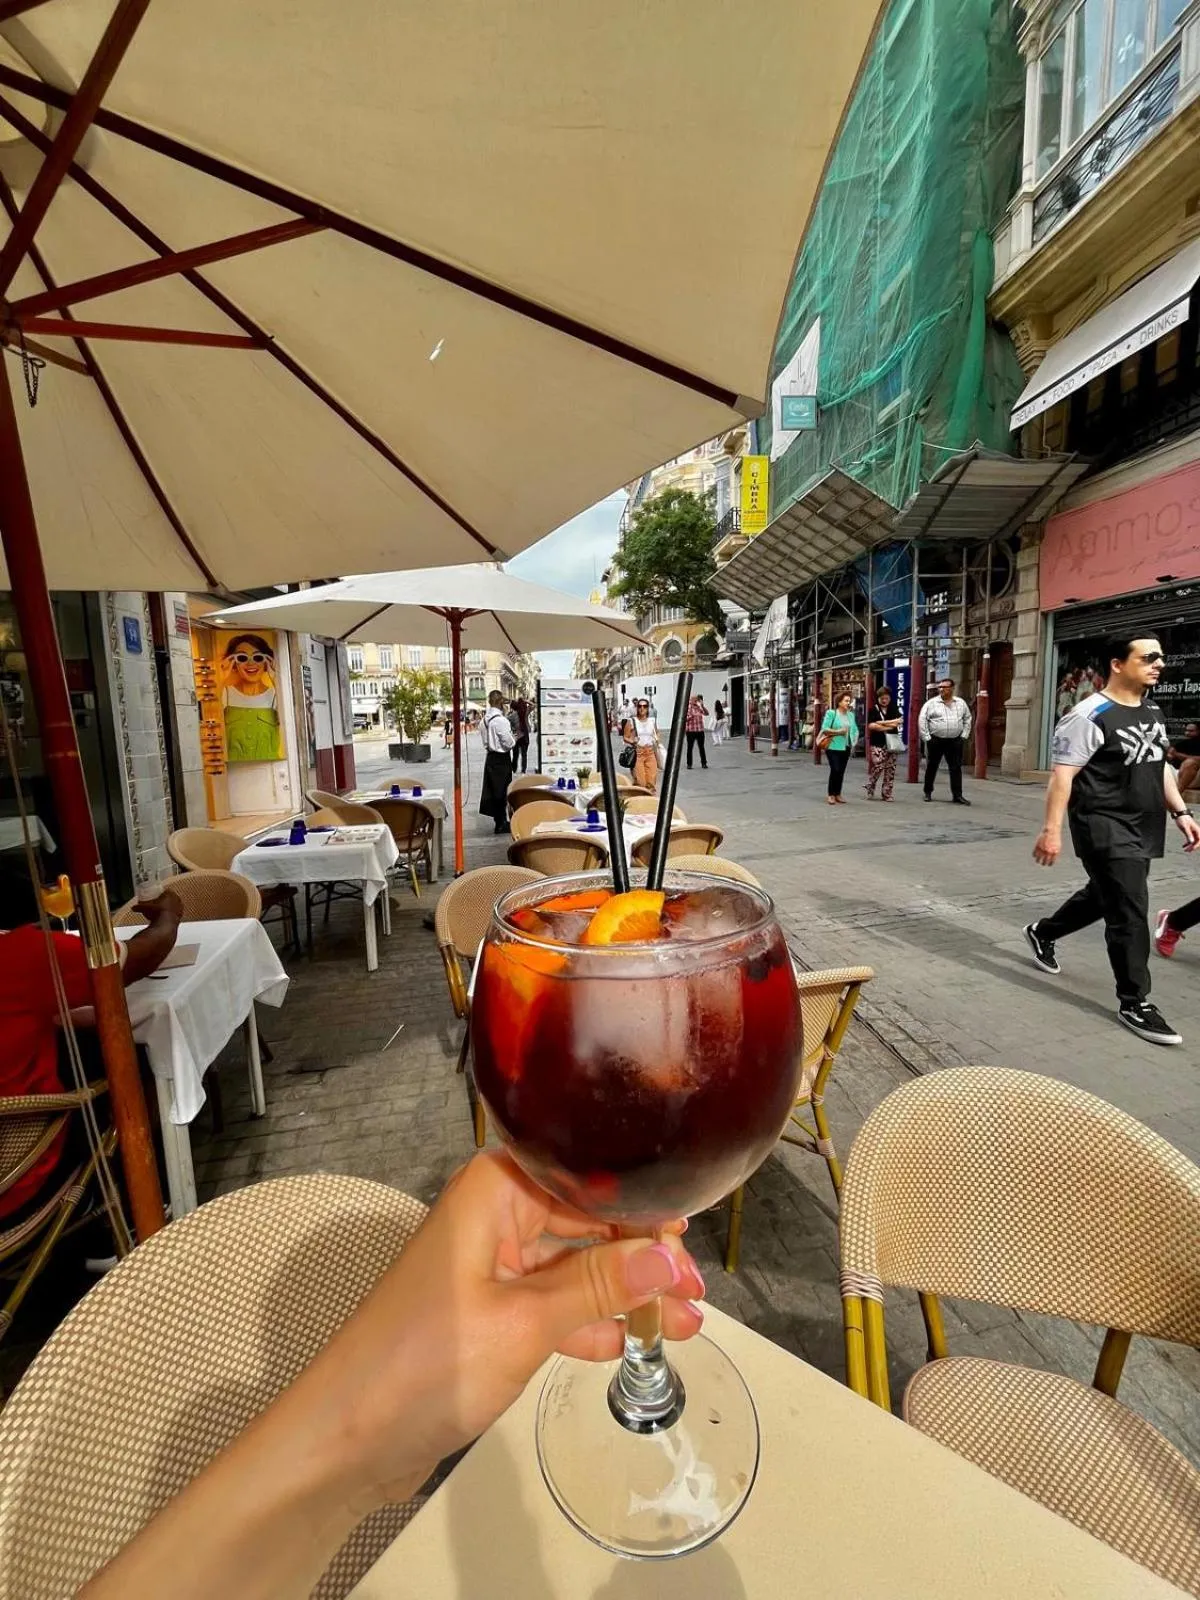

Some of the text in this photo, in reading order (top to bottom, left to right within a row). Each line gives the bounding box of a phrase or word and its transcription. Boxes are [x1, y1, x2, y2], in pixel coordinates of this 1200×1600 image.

[1014, 309, 1180, 424] RELAX FOOD PIZZA DRINKS
[896, 672, 905, 740] EXCHAGE
[1152, 681, 1177, 693] Cañas
